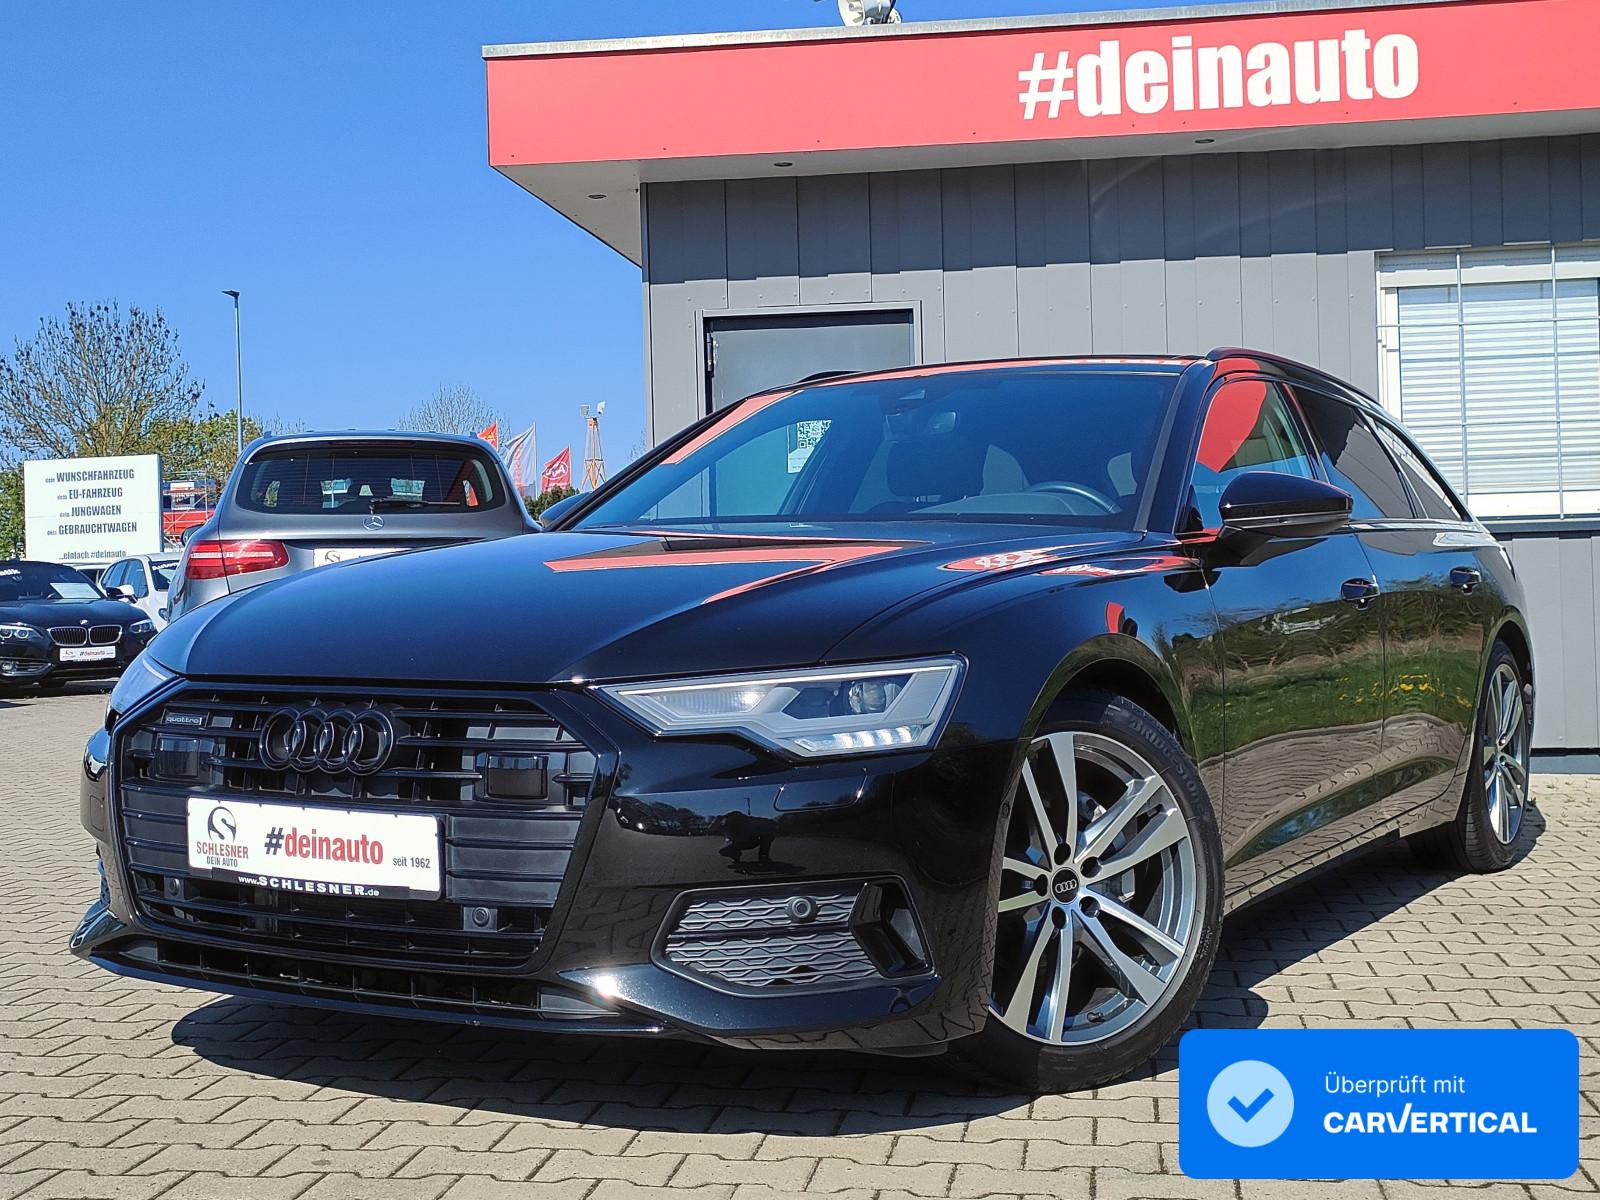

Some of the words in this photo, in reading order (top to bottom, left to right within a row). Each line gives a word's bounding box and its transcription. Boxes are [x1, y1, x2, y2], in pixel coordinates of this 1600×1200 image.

[1018, 29, 1419, 120] #deinauto
[56, 469, 135, 482] WUNSCHFAHRZEUG
[68, 487, 123, 500] EU-FAHRZEUG
[71, 505, 122, 517] JUNGWAGEN
[58, 522, 137, 534] GEBRAUCHTWAGEN
[166, 716, 200, 725] quattro
[196, 841, 249, 859] SCHLESNER
[264, 826, 383, 865] #deinauto
[206, 856, 221, 865] DEIN
[222, 858, 238, 868] AUTO
[393, 856, 408, 867] seit
[410, 857, 431, 869] 1962
[238, 875, 380, 897] www.SCHLESNER.de
